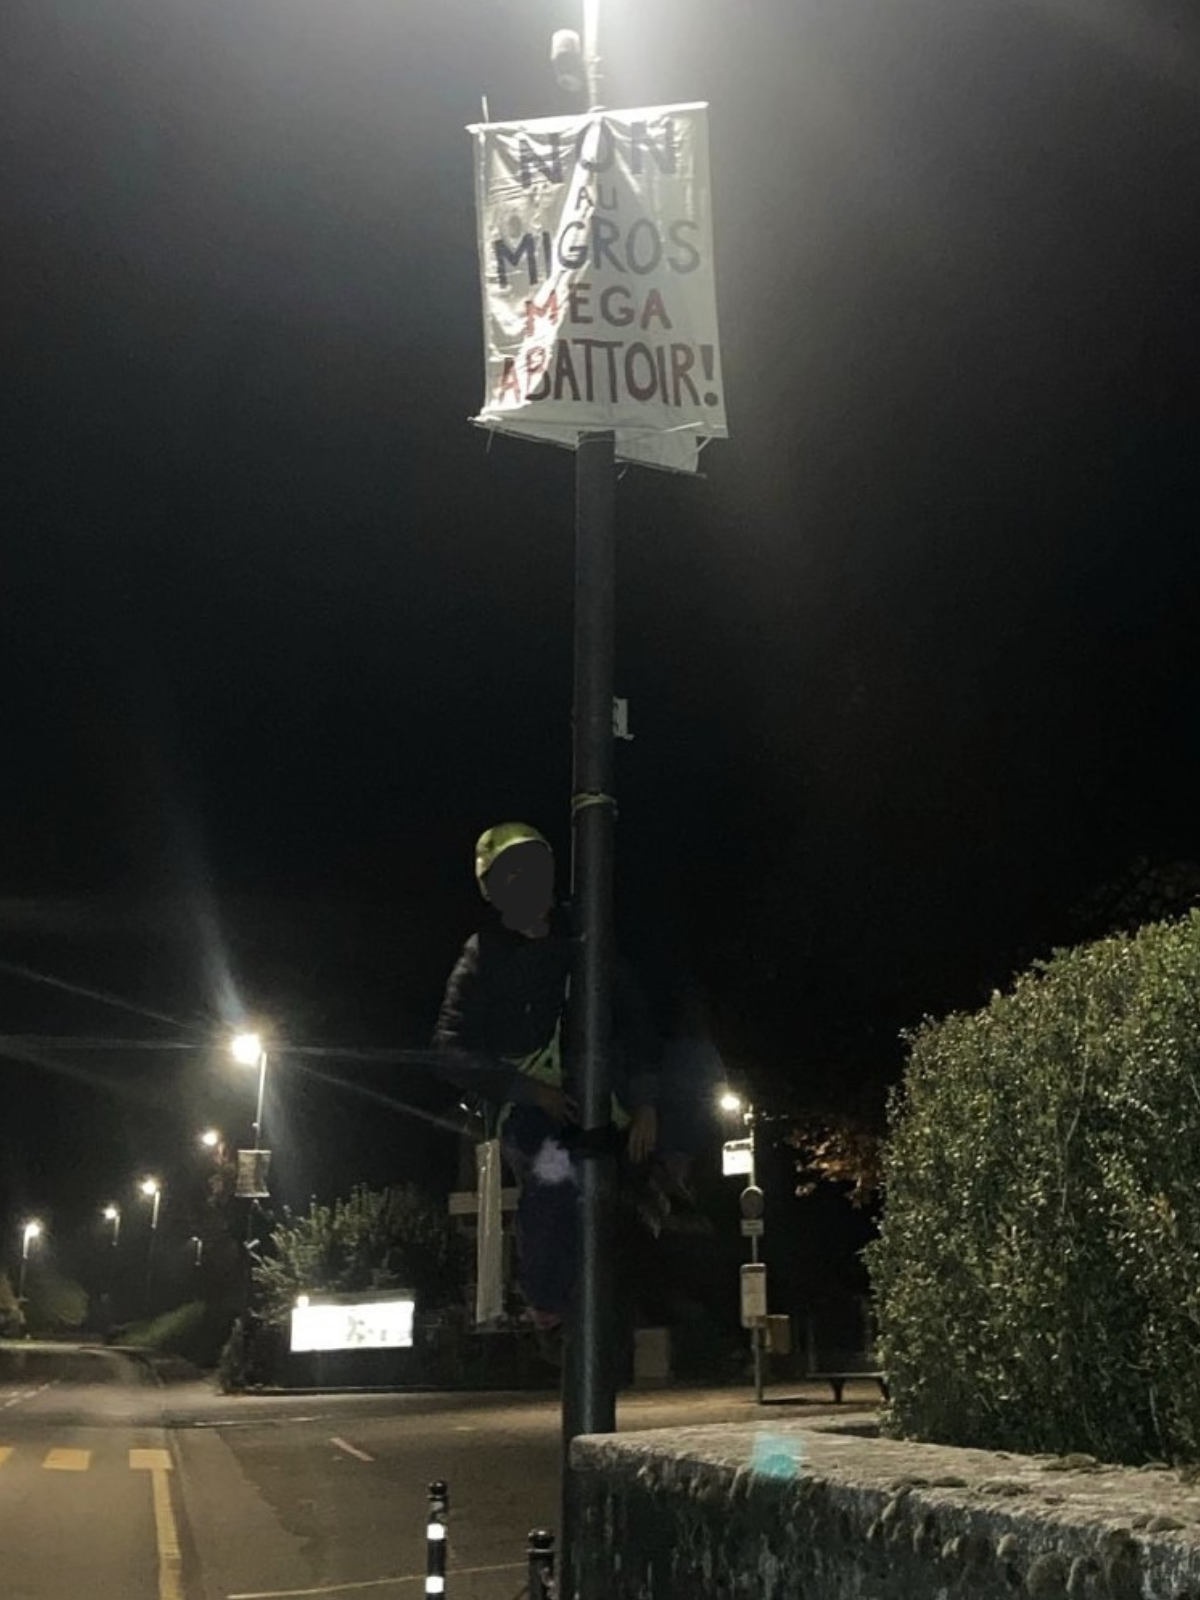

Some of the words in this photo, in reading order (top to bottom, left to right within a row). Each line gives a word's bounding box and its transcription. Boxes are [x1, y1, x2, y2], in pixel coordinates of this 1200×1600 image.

[518, 118, 677, 188] NON
[494, 218, 700, 286] MIGROS
[524, 283, 672, 337] MEGA
[498, 339, 720, 409] ABATTOIR!
